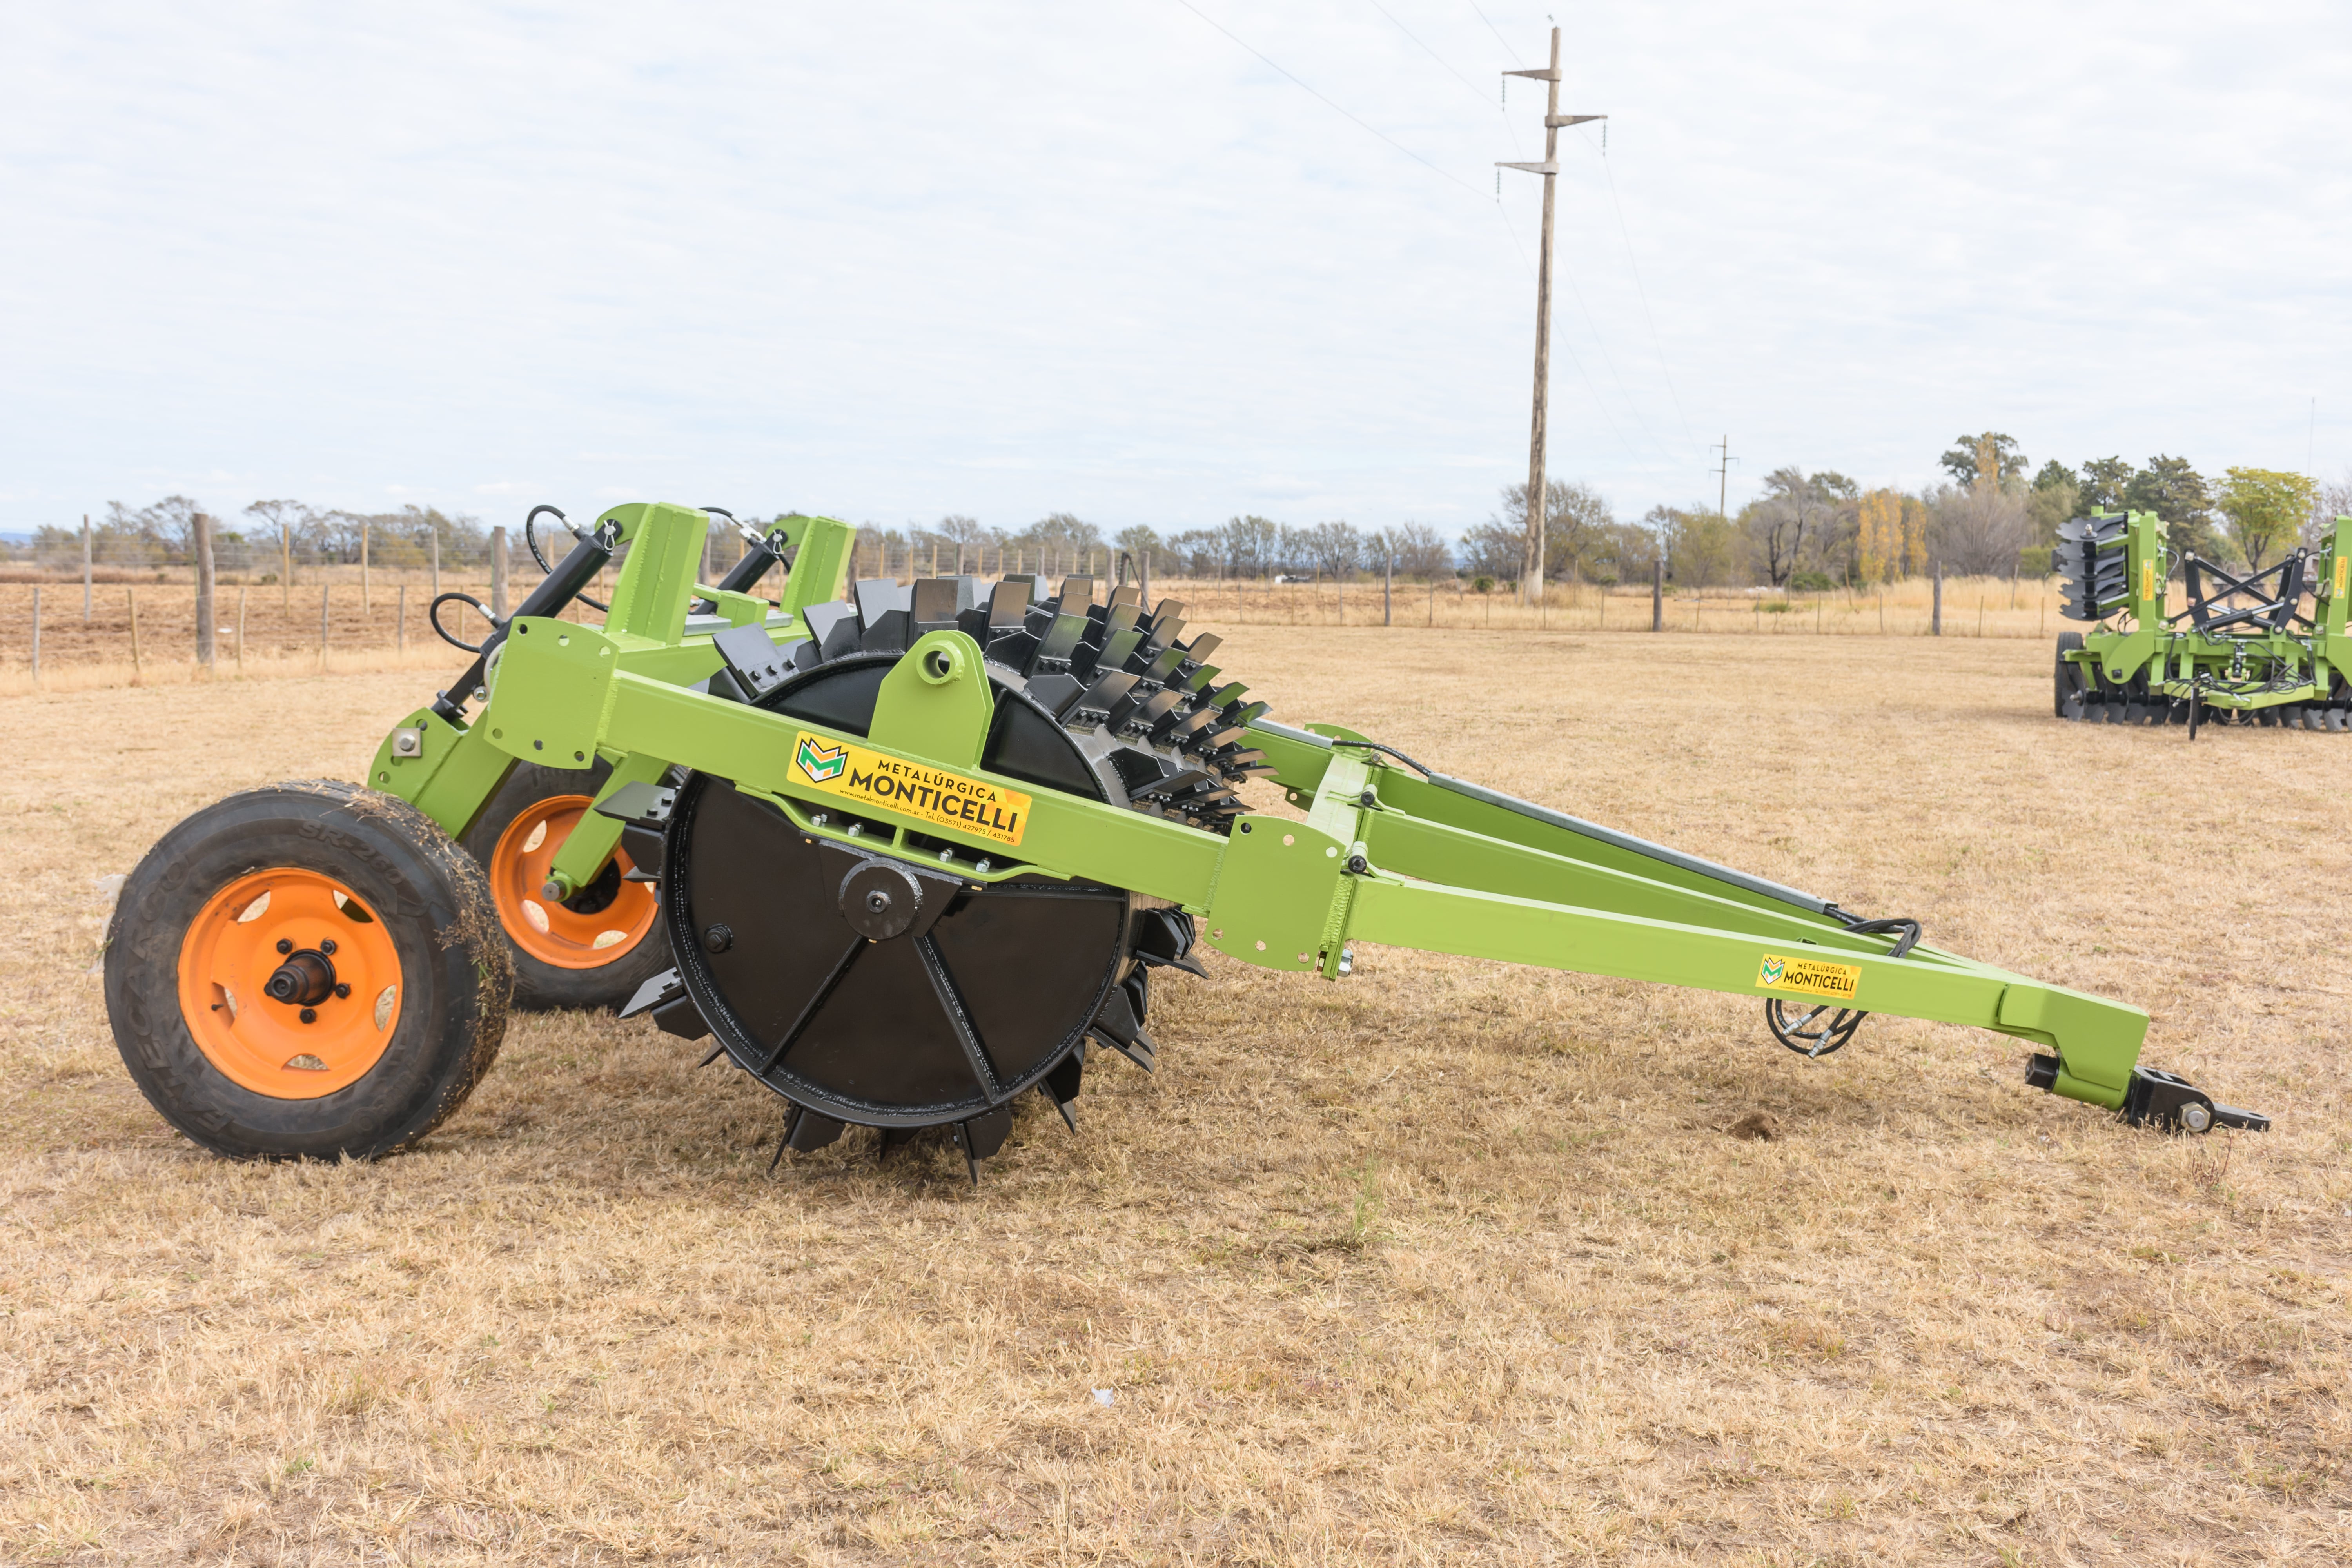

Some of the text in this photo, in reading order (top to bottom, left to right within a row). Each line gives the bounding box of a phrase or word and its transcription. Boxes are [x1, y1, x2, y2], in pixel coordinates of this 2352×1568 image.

[849, 767, 1018, 833] MONTICELLI
[878, 759, 996, 802] METALÚRGICA
[840, 790, 920, 815] www.metalmonticelli.com.ar
[926, 811, 935, 820] Tel.
[936, 815, 962, 828] (03571)
[963, 824, 986, 835] 427975
[992, 833, 1014, 842] 431785
[298, 819, 405, 884] SR-260
[1784, 970, 1854, 991] MONTICELLI
[1797, 962, 1846, 975] METALÚRGICA
